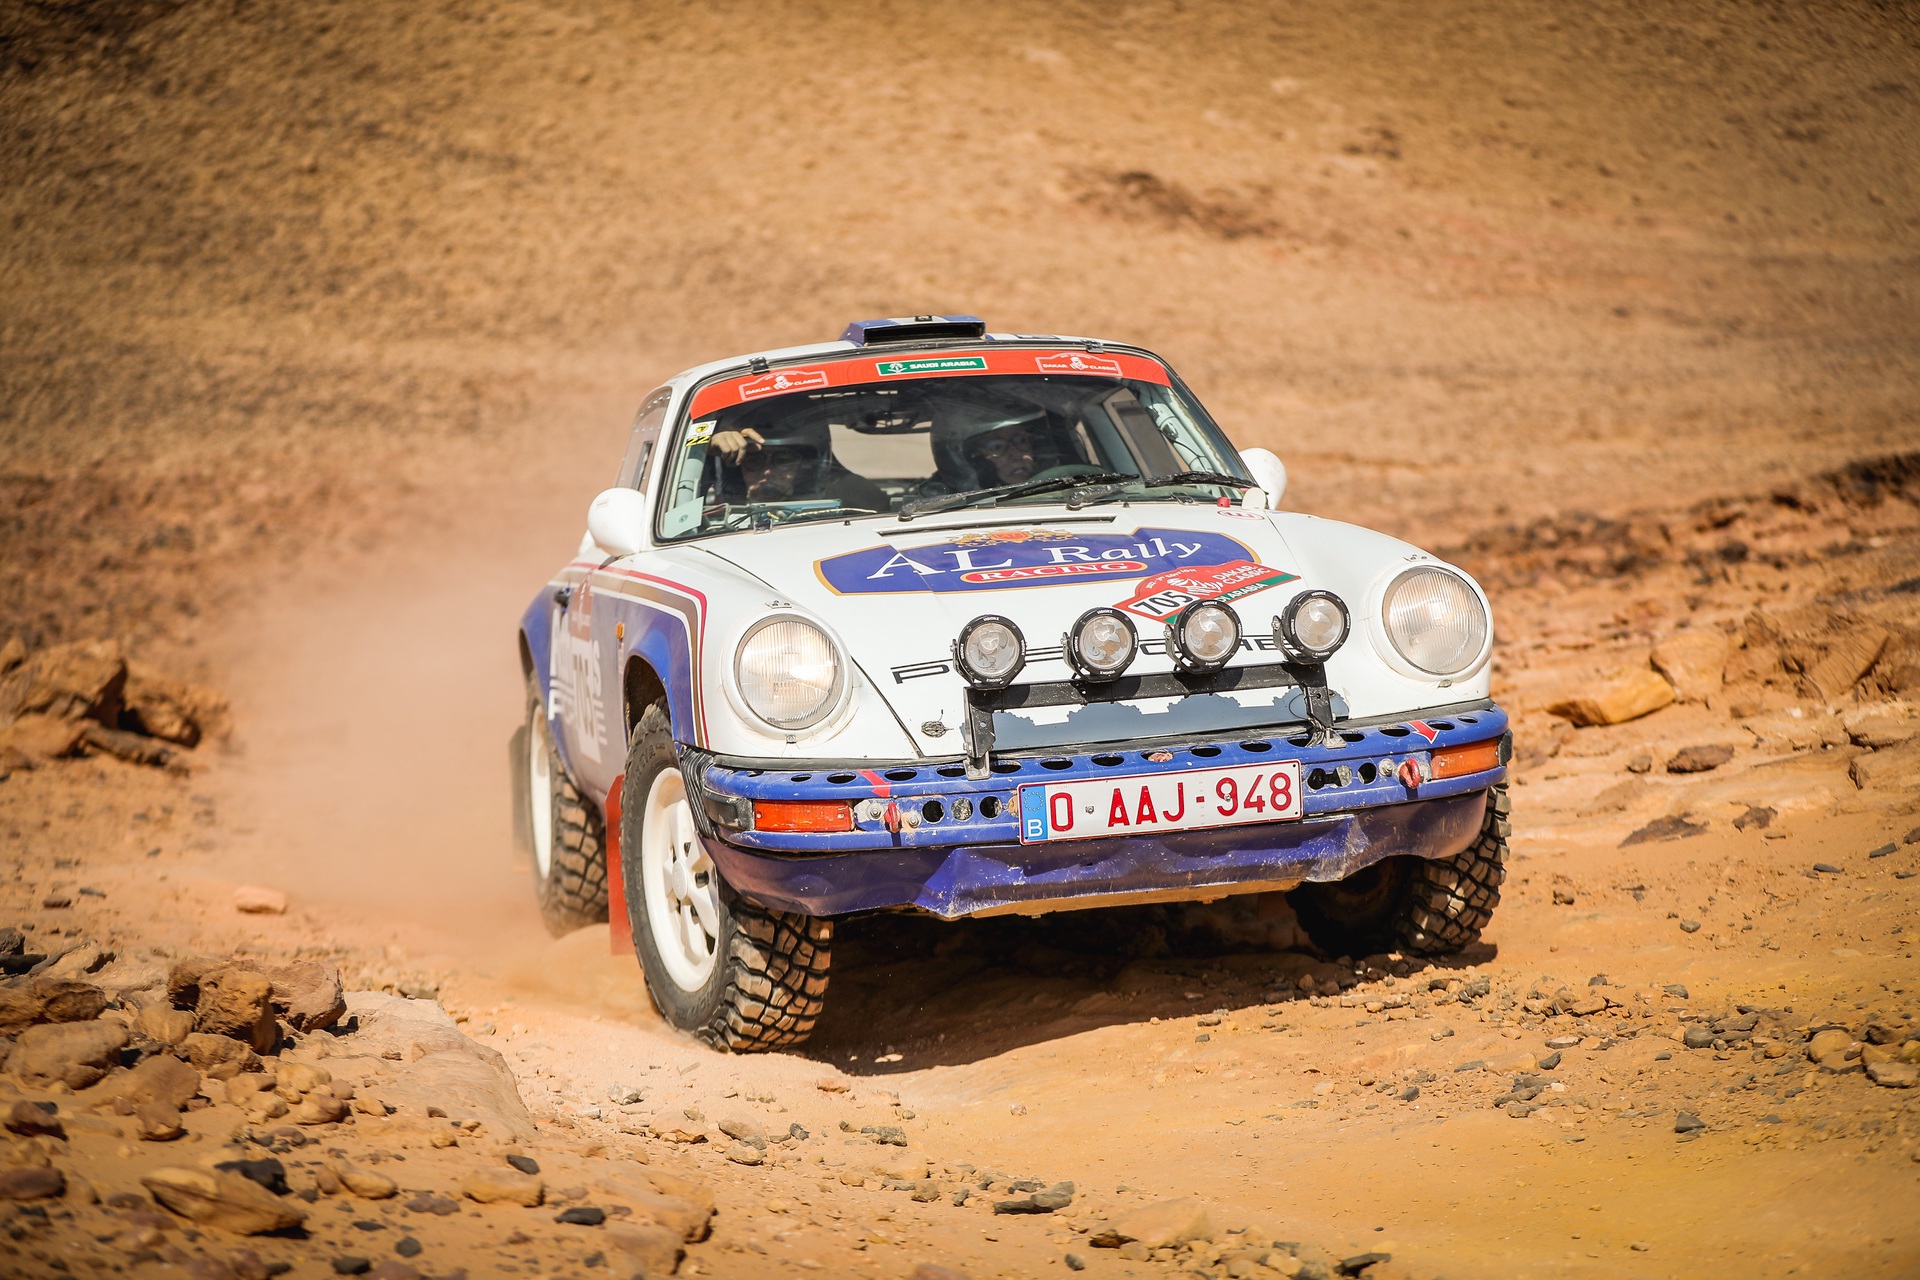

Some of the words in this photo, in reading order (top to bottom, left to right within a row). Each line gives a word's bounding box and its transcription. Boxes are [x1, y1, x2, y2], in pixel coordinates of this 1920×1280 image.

[909, 362, 939, 370] SAUDI
[940, 360, 977, 368] ARABIA
[866, 548, 1013, 580] AL
[1041, 537, 1202, 564] Rally
[978, 562, 1129, 581] RACING
[1211, 565, 1258, 580] DAKAR
[1222, 568, 1271, 585] CLASSIC
[1227, 583, 1269, 598] ARABIA
[1133, 591, 1194, 615] 705
[1027, 819, 1043, 837] B
